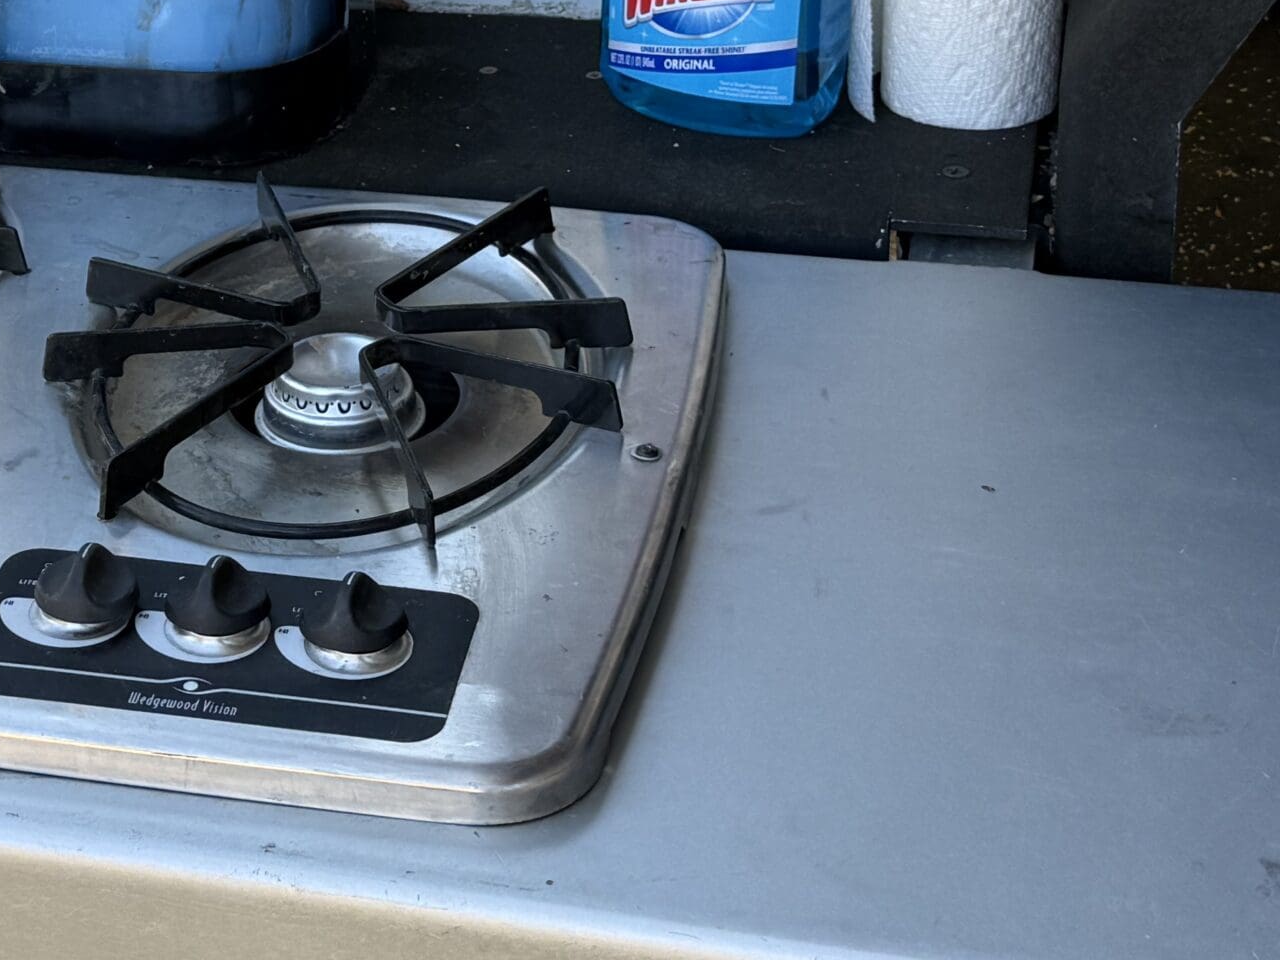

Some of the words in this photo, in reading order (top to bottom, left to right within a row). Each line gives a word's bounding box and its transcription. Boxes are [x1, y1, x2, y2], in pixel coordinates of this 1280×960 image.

[663, 58, 716, 71] ORIGINAL
[127, 691, 200, 712] Wedgewood
[201, 697, 238, 717] Vision
